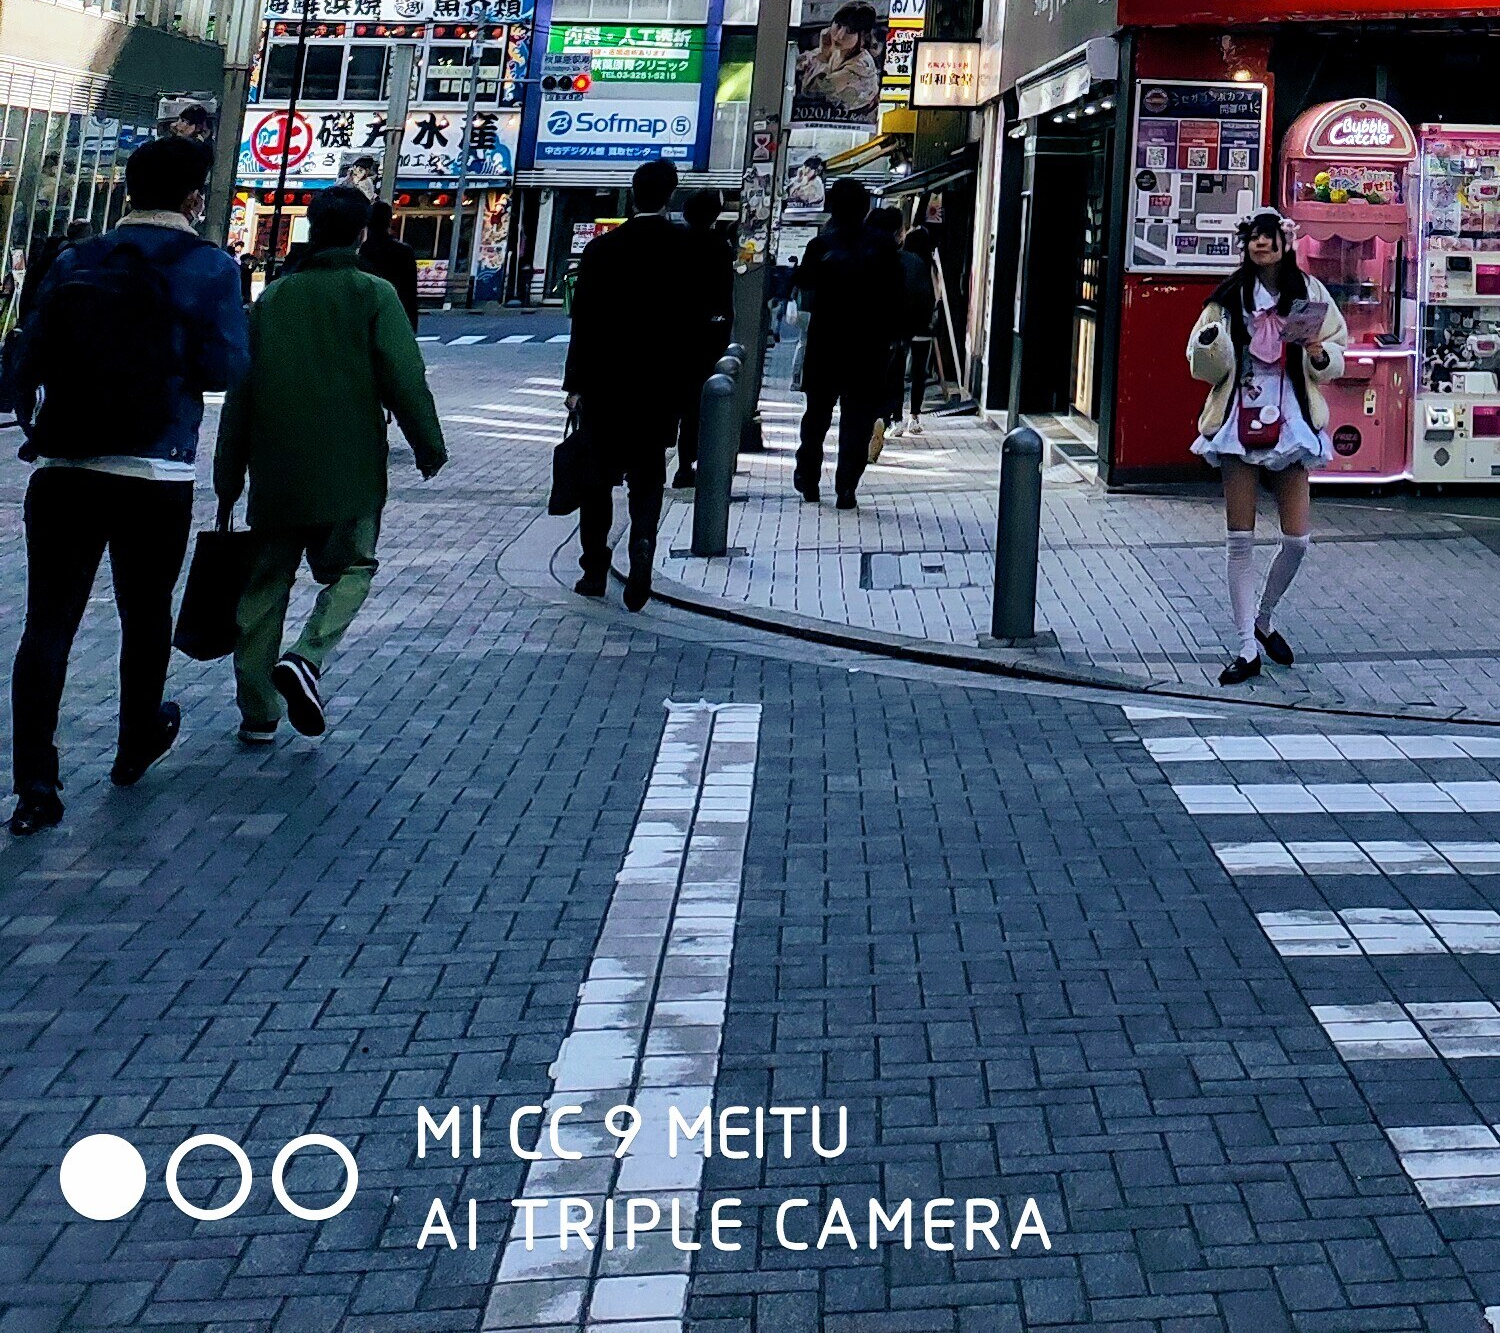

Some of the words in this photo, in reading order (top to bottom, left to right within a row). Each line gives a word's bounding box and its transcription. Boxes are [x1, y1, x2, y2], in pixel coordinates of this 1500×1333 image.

[575, 113, 667, 138] Sofmap
[1329, 123, 1394, 145] Catcher
[1342, 117, 1389, 134] Bubble
